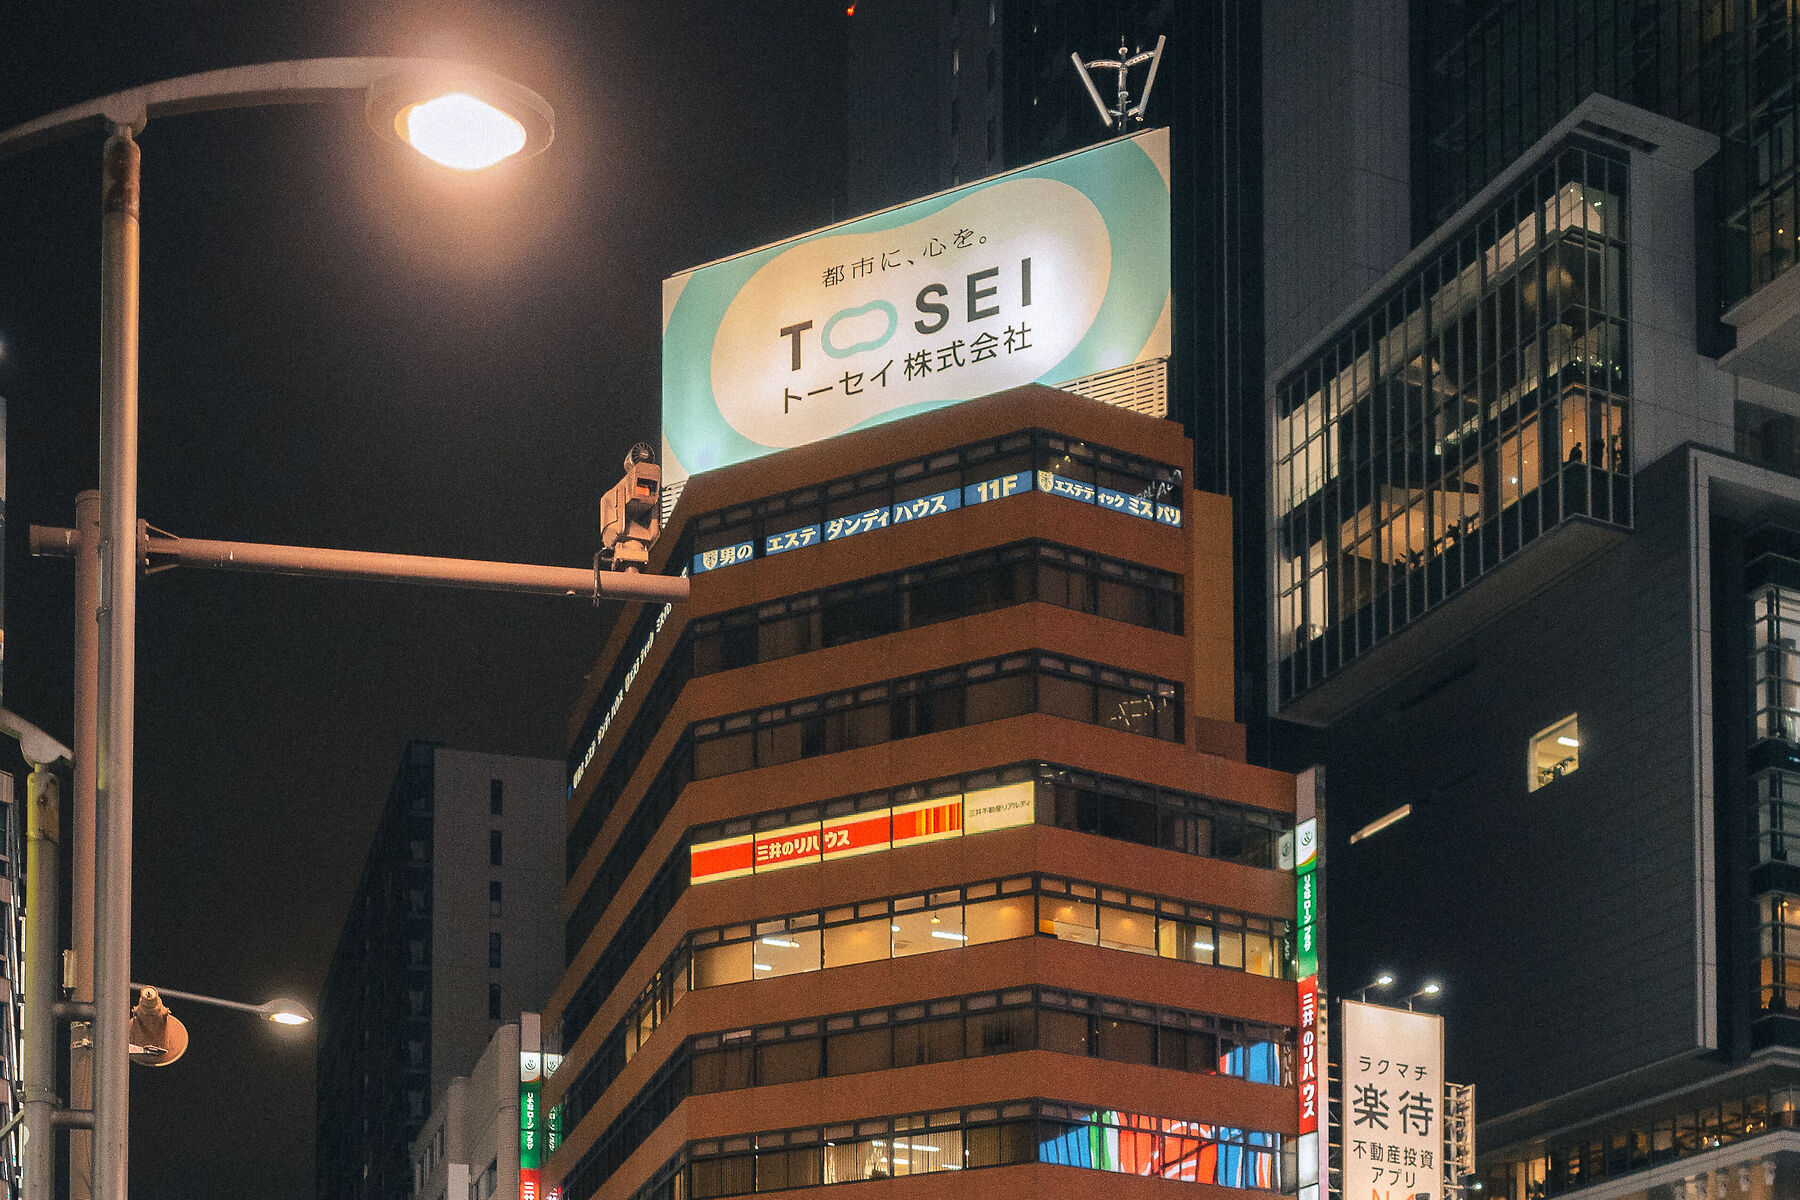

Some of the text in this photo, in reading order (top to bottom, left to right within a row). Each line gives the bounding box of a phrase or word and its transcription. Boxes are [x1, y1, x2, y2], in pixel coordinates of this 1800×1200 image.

[821, 227, 990, 289] 都市に、心を。
[780, 257, 1033, 372] TOSEI
[783, 321, 1033, 414] トーセイ株式会社
[977, 473, 1018, 502] 11F
[968, 800, 1031, 818] 三井不動産リアルティ
[756, 829, 850, 862] 三井のリハウス
[1302, 993, 1315, 1118] 三井のリハウス
[1359, 1056, 1427, 1081] ラクマチ
[1352, 1083, 1434, 1136] 楽待
[1353, 1139, 1434, 1170] 不動産投資
[1372, 1166, 1416, 1188] アプリ
